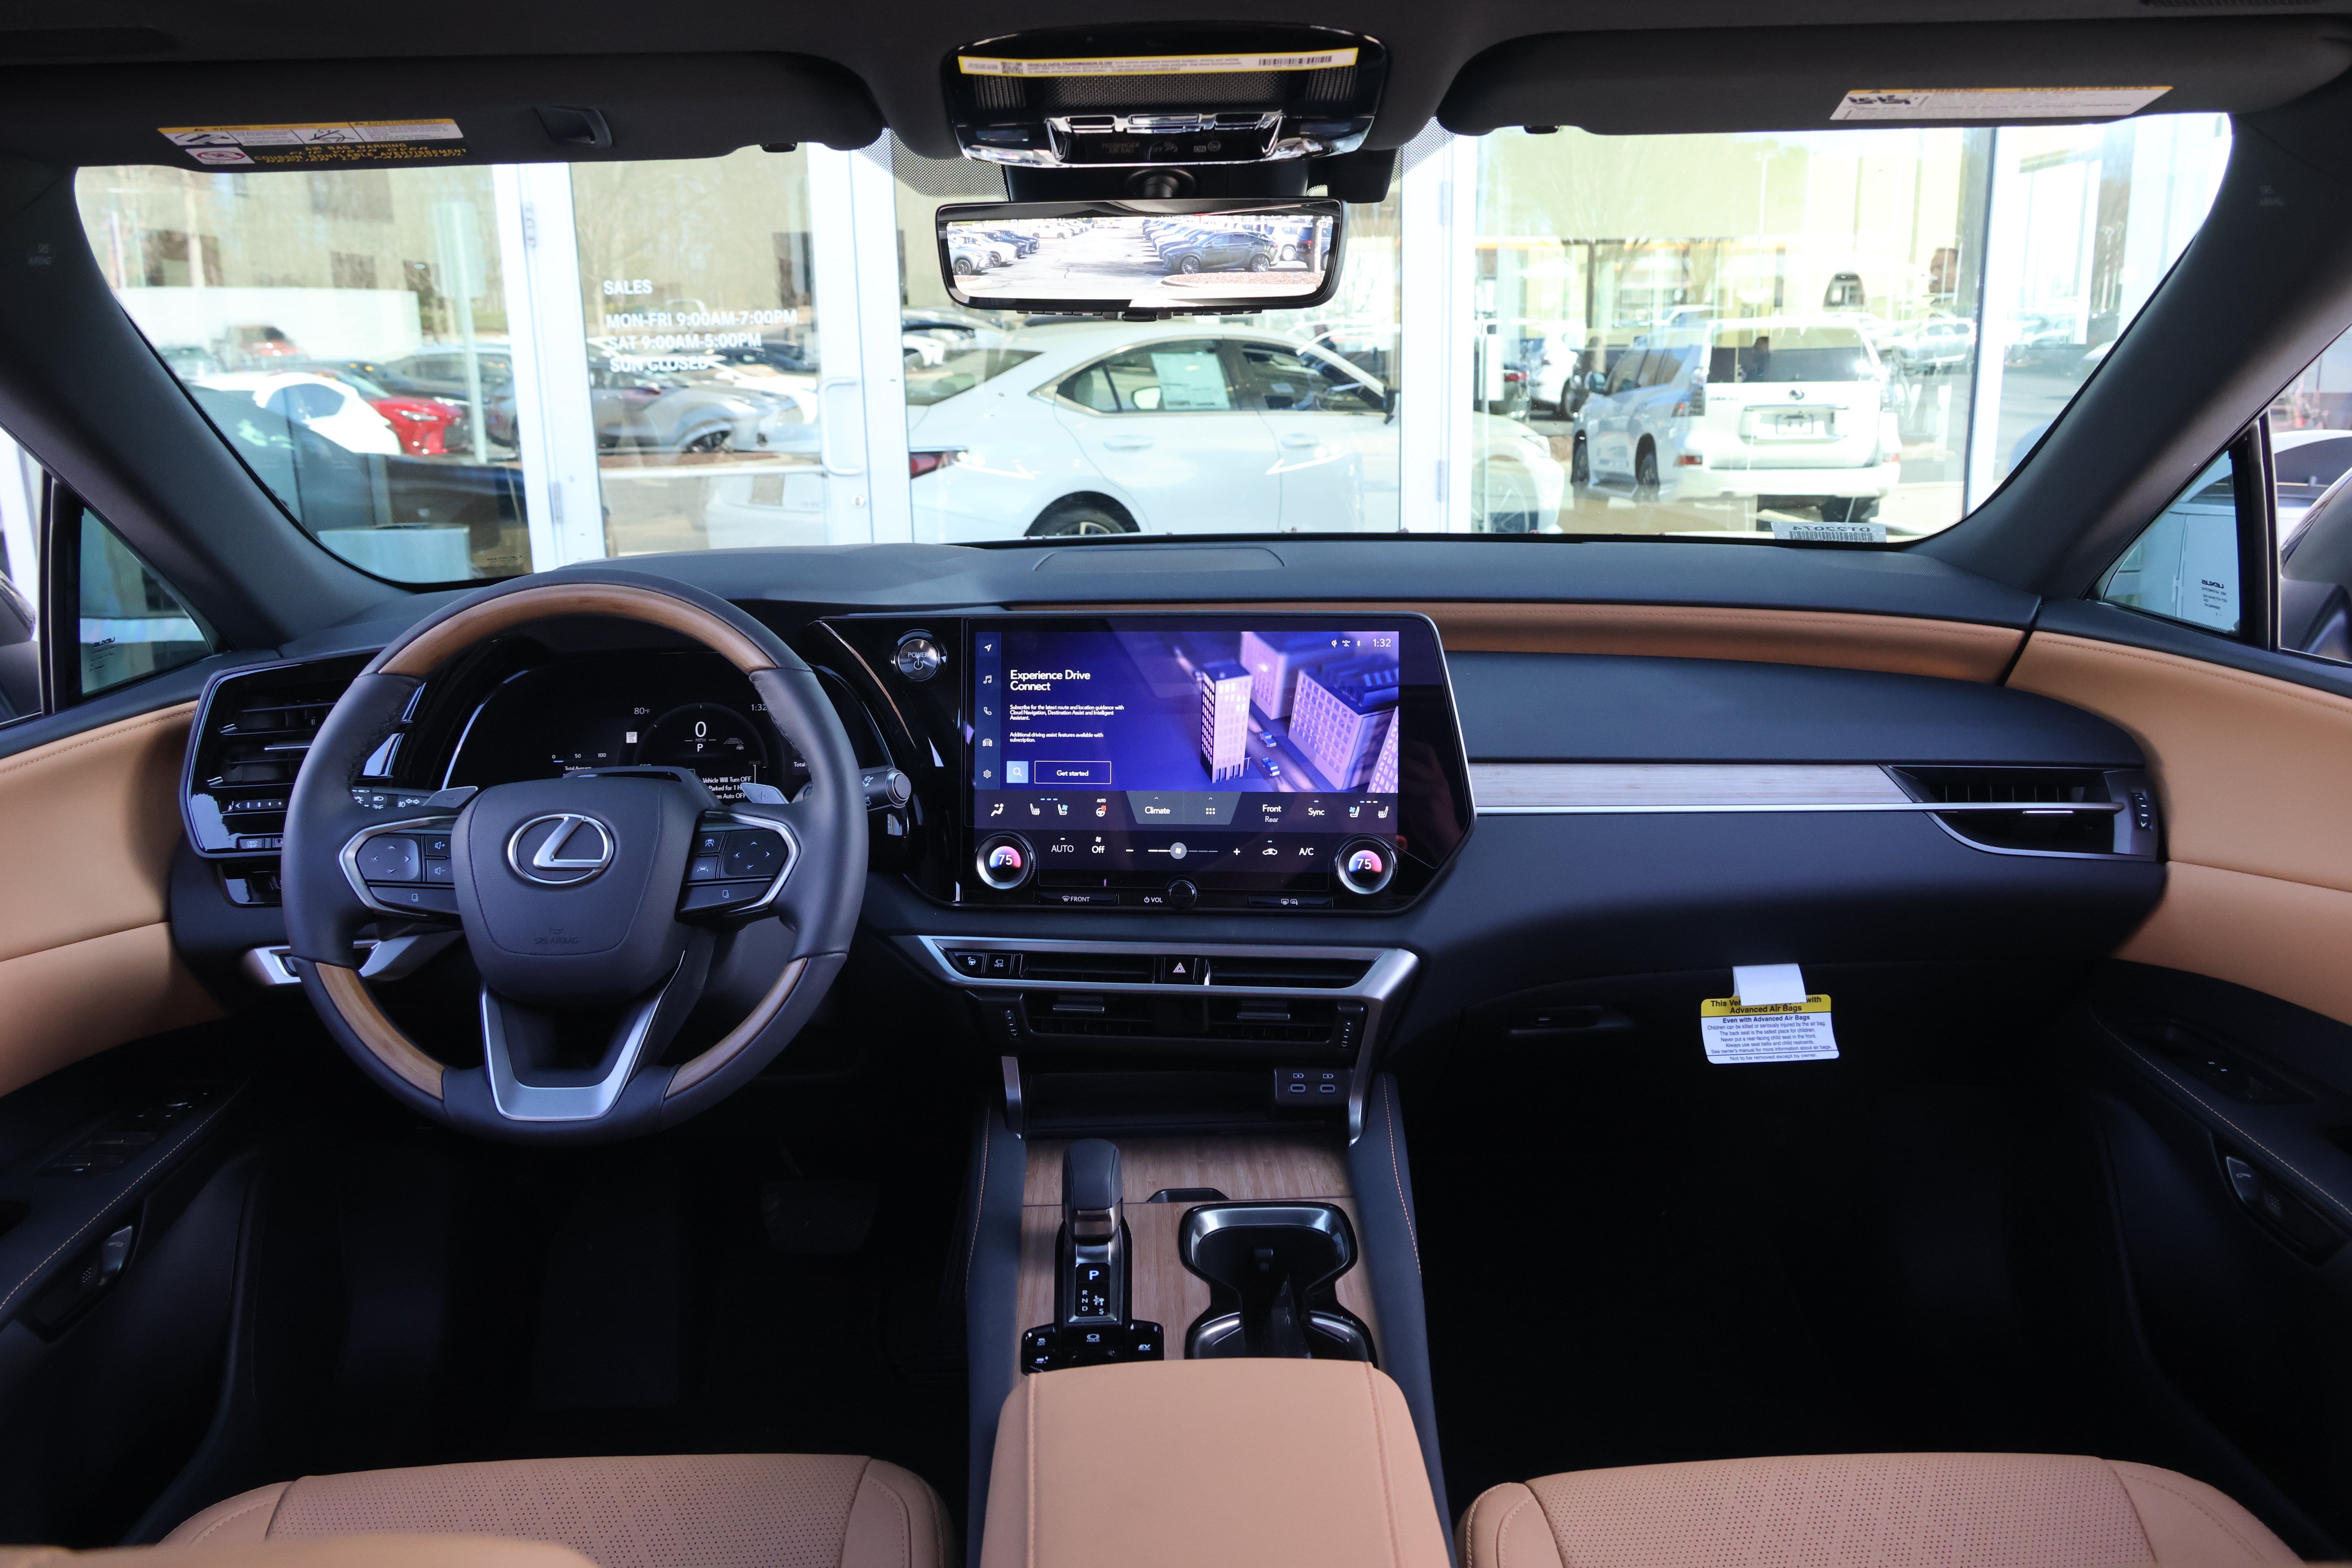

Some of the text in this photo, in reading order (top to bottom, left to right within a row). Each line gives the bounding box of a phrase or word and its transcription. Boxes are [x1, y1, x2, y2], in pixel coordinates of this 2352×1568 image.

[604, 279, 653, 296] SALES
[606, 309, 797, 328] MON-FRI 9:00AM-7:00PM
[607, 332, 762, 351] SAT 9:00AM-5:00PM
[610, 354, 709, 373] SUN CLOSED
[1372, 638, 1392, 648] 1:32
[1010, 669, 1091, 682] Experience Drive
[1010, 681, 1051, 691] Connect
[695, 721, 707, 737] 0
[697, 744, 704, 752] P
[1144, 806, 1171, 815] Climate
[1262, 804, 1281, 813] Front
[1308, 808, 1325, 817] Sync
[1051, 845, 1074, 853] AUTO
[1091, 845, 1105, 854] Off
[1298, 848, 1314, 856] A/C
[998, 854, 1013, 866] 75
[1356, 859, 1372, 870] 75
[1089, 1270, 1099, 1280] P
